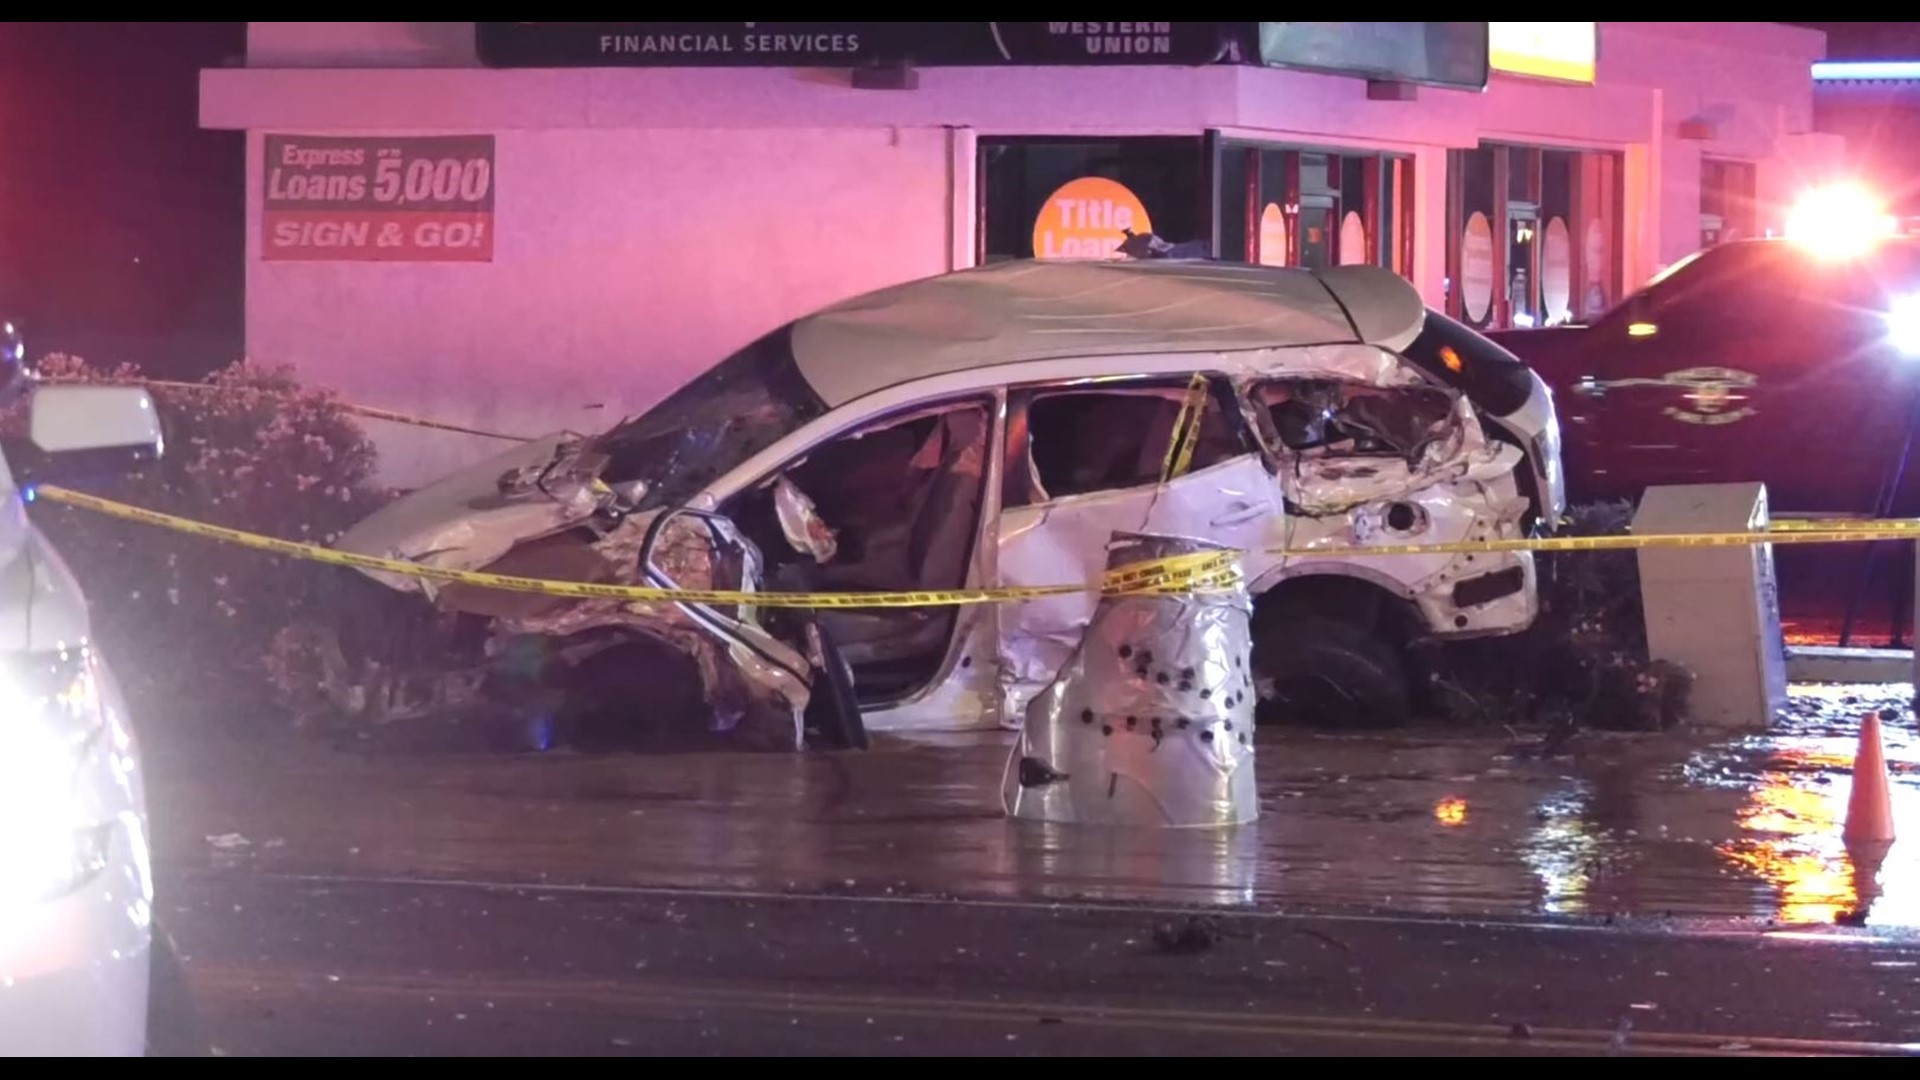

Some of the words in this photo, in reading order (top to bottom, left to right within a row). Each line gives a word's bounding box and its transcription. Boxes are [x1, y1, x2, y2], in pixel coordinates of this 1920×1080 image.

[1048, 22, 1170, 34] WESTERN
[600, 35, 734, 53] FINANCIAL
[743, 34, 860, 52] SERVICES
[1085, 36, 1170, 53] UNION
[282, 144, 365, 170] Express
[267, 168, 366, 200] Loans
[373, 158, 491, 205] 5,000
[1056, 199, 1133, 230] Title
[273, 221, 369, 247] SIGN
[376, 221, 403, 247] &
[413, 221, 485, 247] GO!
